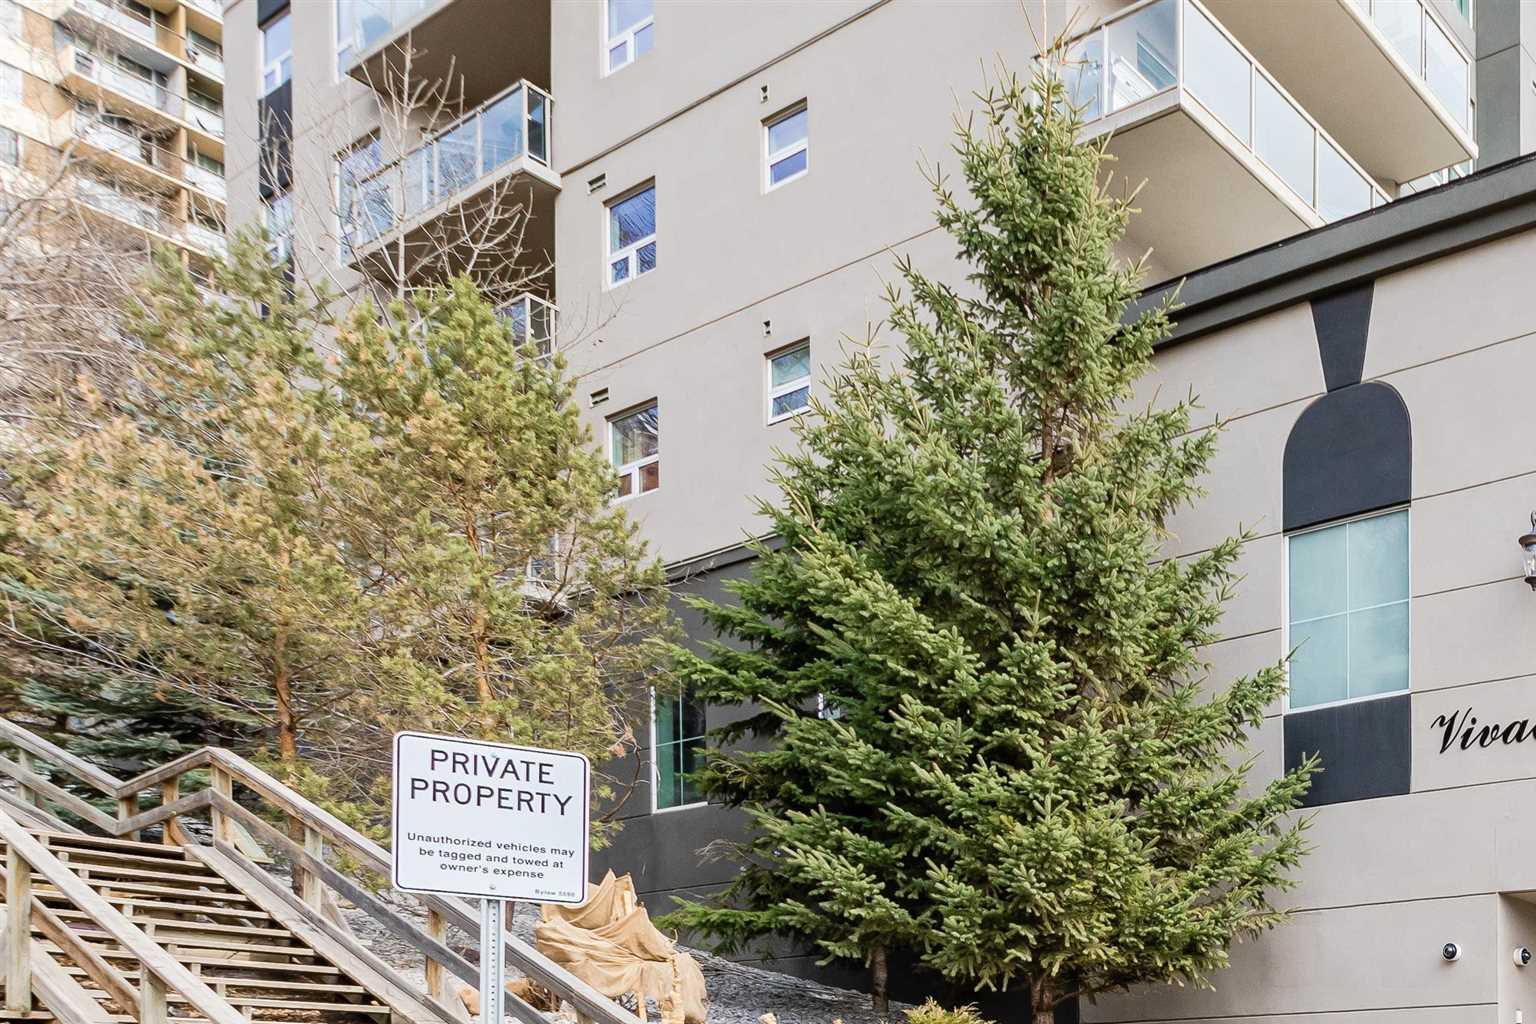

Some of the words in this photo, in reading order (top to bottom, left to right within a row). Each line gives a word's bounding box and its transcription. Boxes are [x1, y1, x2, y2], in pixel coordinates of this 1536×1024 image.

[431, 749, 555, 785] PRIVATE
[410, 778, 573, 816] PROPERTY
[407, 832, 492, 849] Unauthorized
[496, 840, 547, 855] vehicles
[551, 847, 575, 858] may
[419, 847, 435, 857] be
[439, 849, 482, 863] tagged
[486, 853, 508, 864] and
[512, 856, 549, 868] towed
[552, 860, 564, 869] at
[440, 862, 489, 874] owner's
[493, 867, 544, 879] expense
